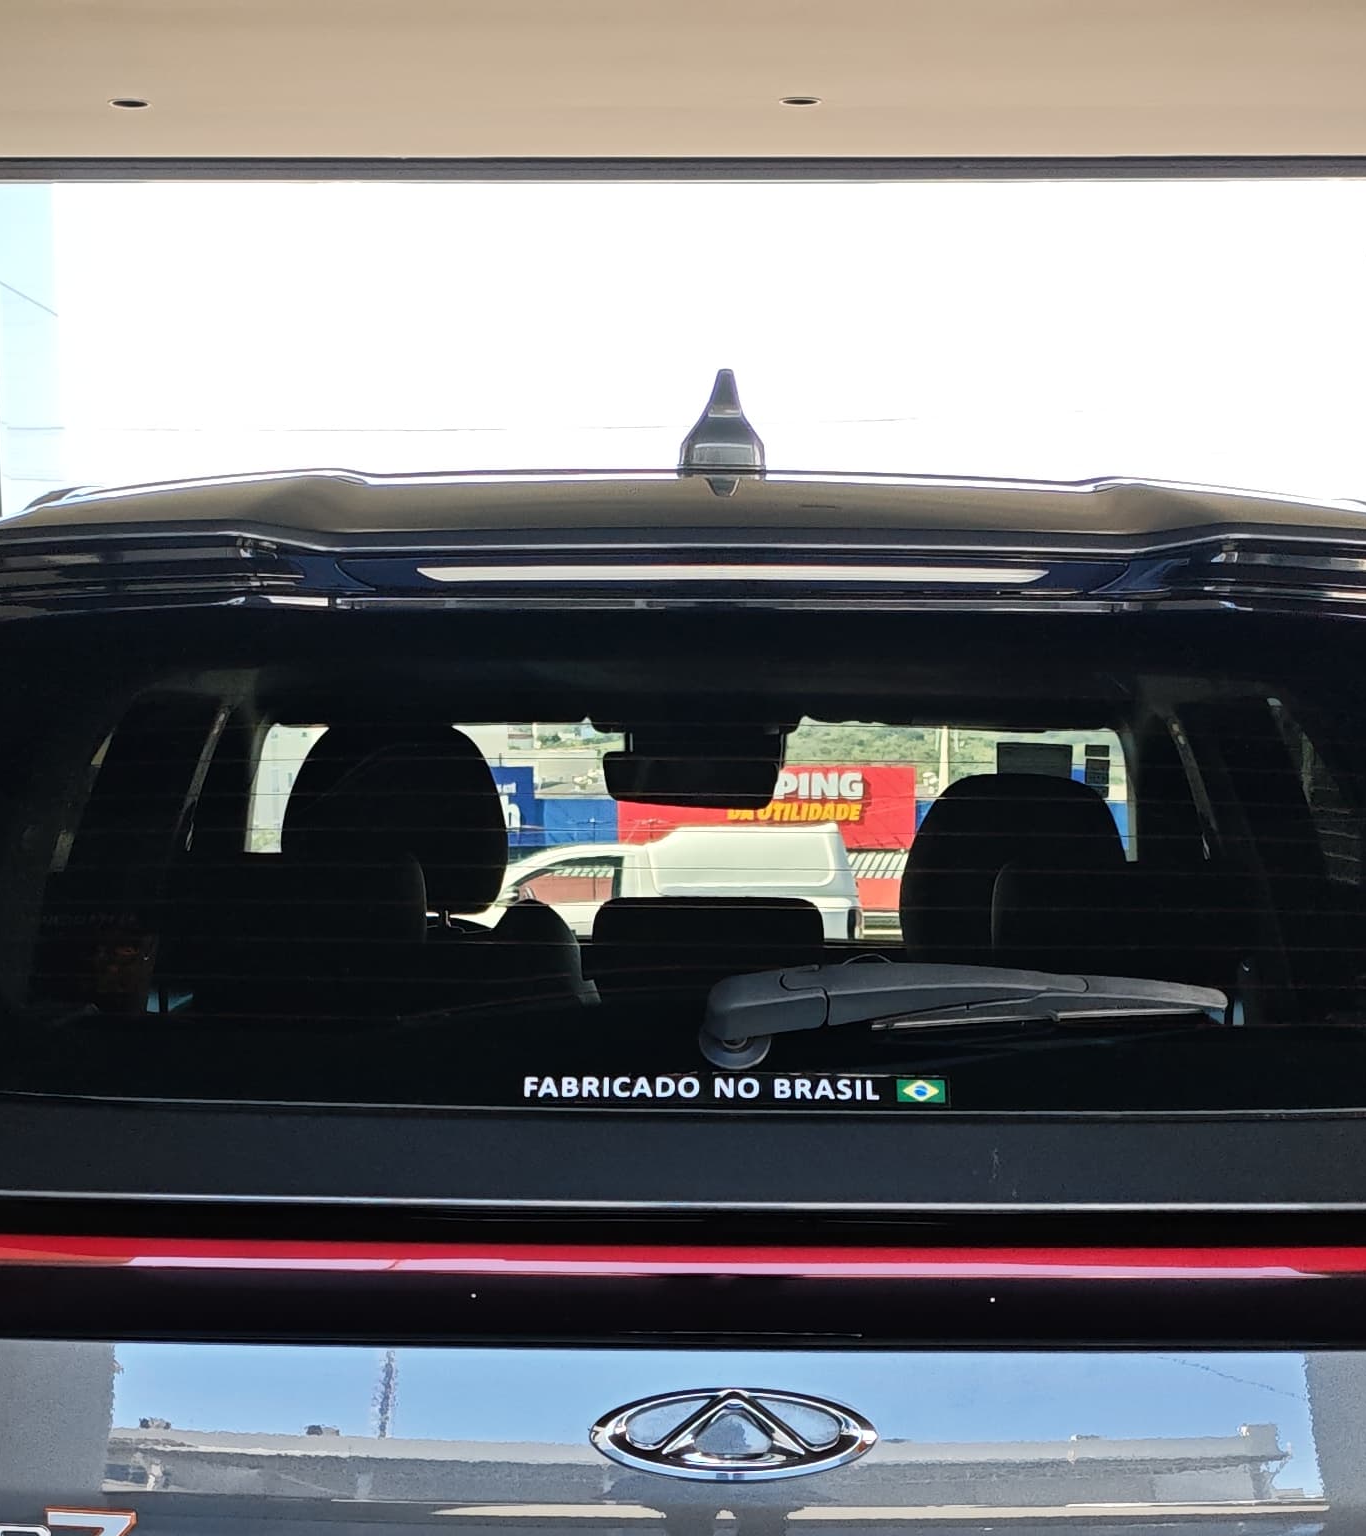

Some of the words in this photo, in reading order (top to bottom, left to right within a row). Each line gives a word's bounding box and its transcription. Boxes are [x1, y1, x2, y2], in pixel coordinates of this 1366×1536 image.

[773, 772, 864, 800] PING
[756, 801, 863, 821] UTILIDADE
[523, 1075, 700, 1098] FABRICADO
[714, 1076, 760, 1099] NO
[773, 1078, 880, 1101] BRASIL
